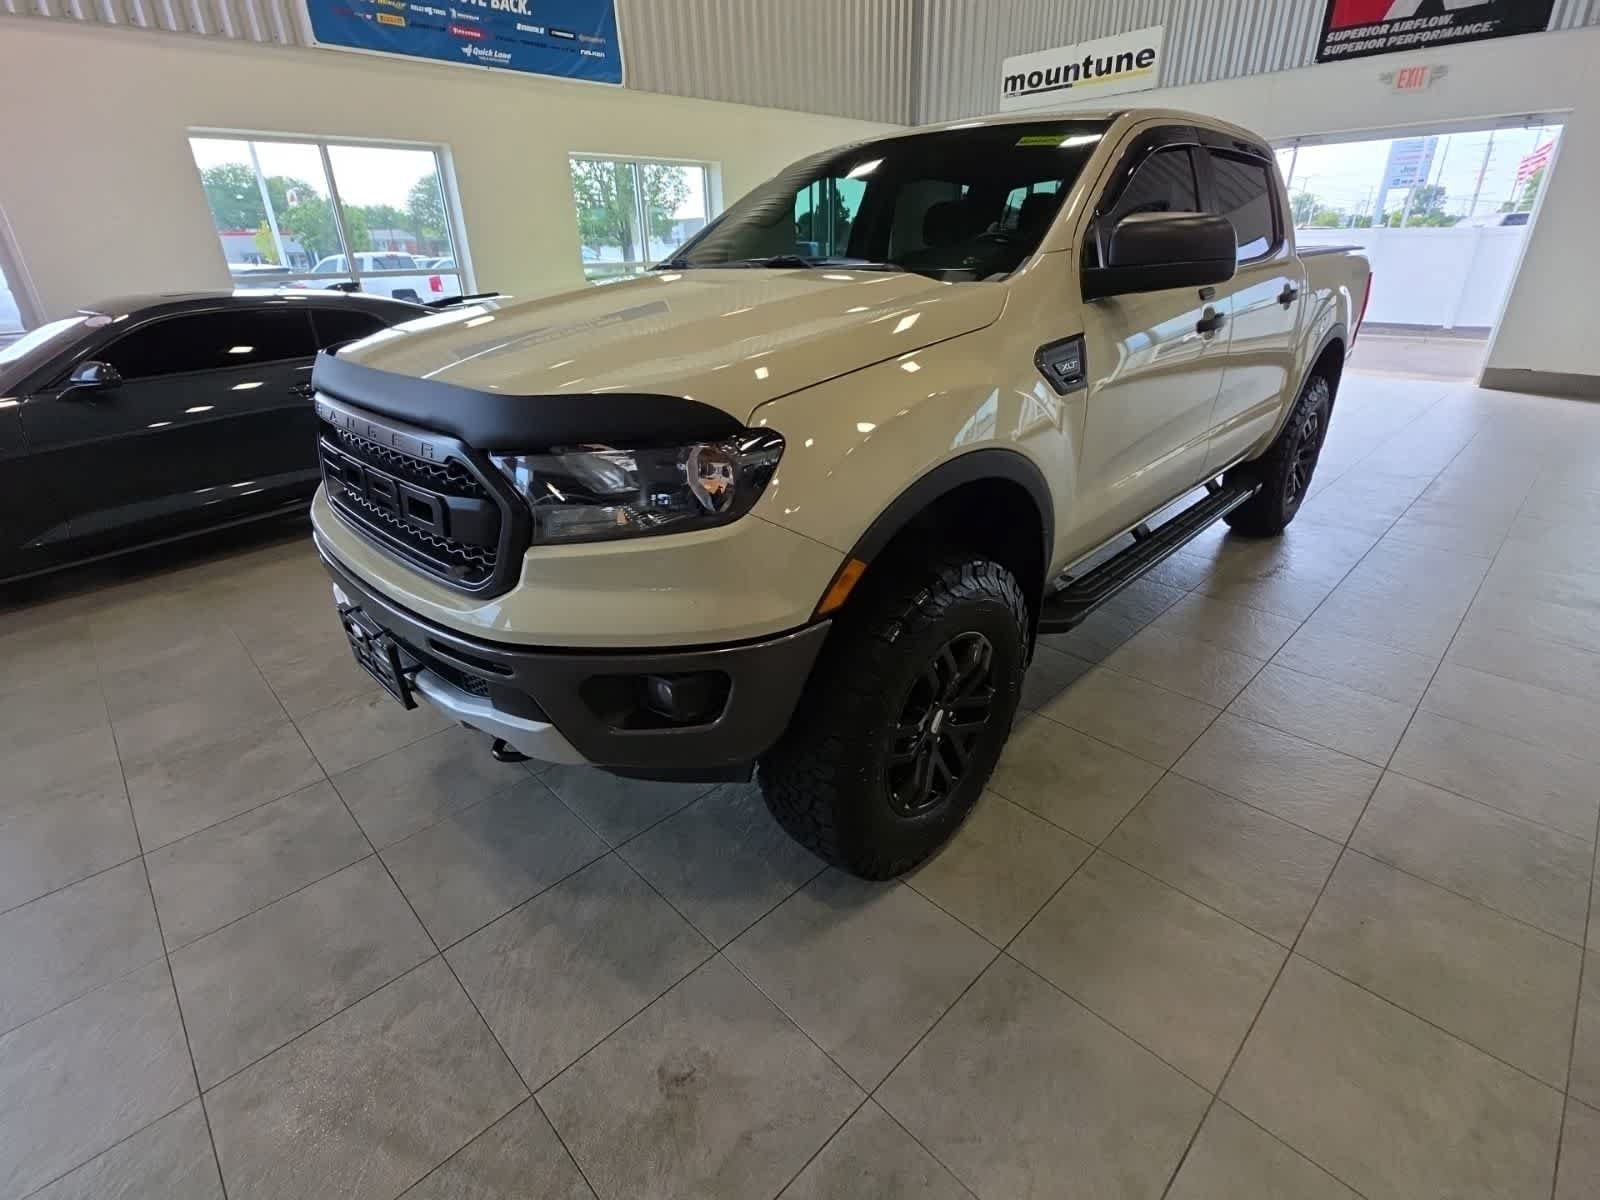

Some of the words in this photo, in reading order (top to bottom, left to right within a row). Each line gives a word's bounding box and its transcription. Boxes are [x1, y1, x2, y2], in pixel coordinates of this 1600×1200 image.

[491, 0, 532, 16] BACK.
[1322, 37, 1385, 56] SUPERIOR
[1386, 20, 1493, 47] PERFORMANCE.
[1326, 24, 1389, 42] SUPERIOR
[1390, 14, 1454, 33] AIRFLOW.
[473, 47, 493, 57] Quick
[494, 49, 512, 60] Lane
[1003, 48, 1156, 93] mountune
[1397, 66, 1427, 89] EXIT
[1062, 360, 1078, 372] XLT
